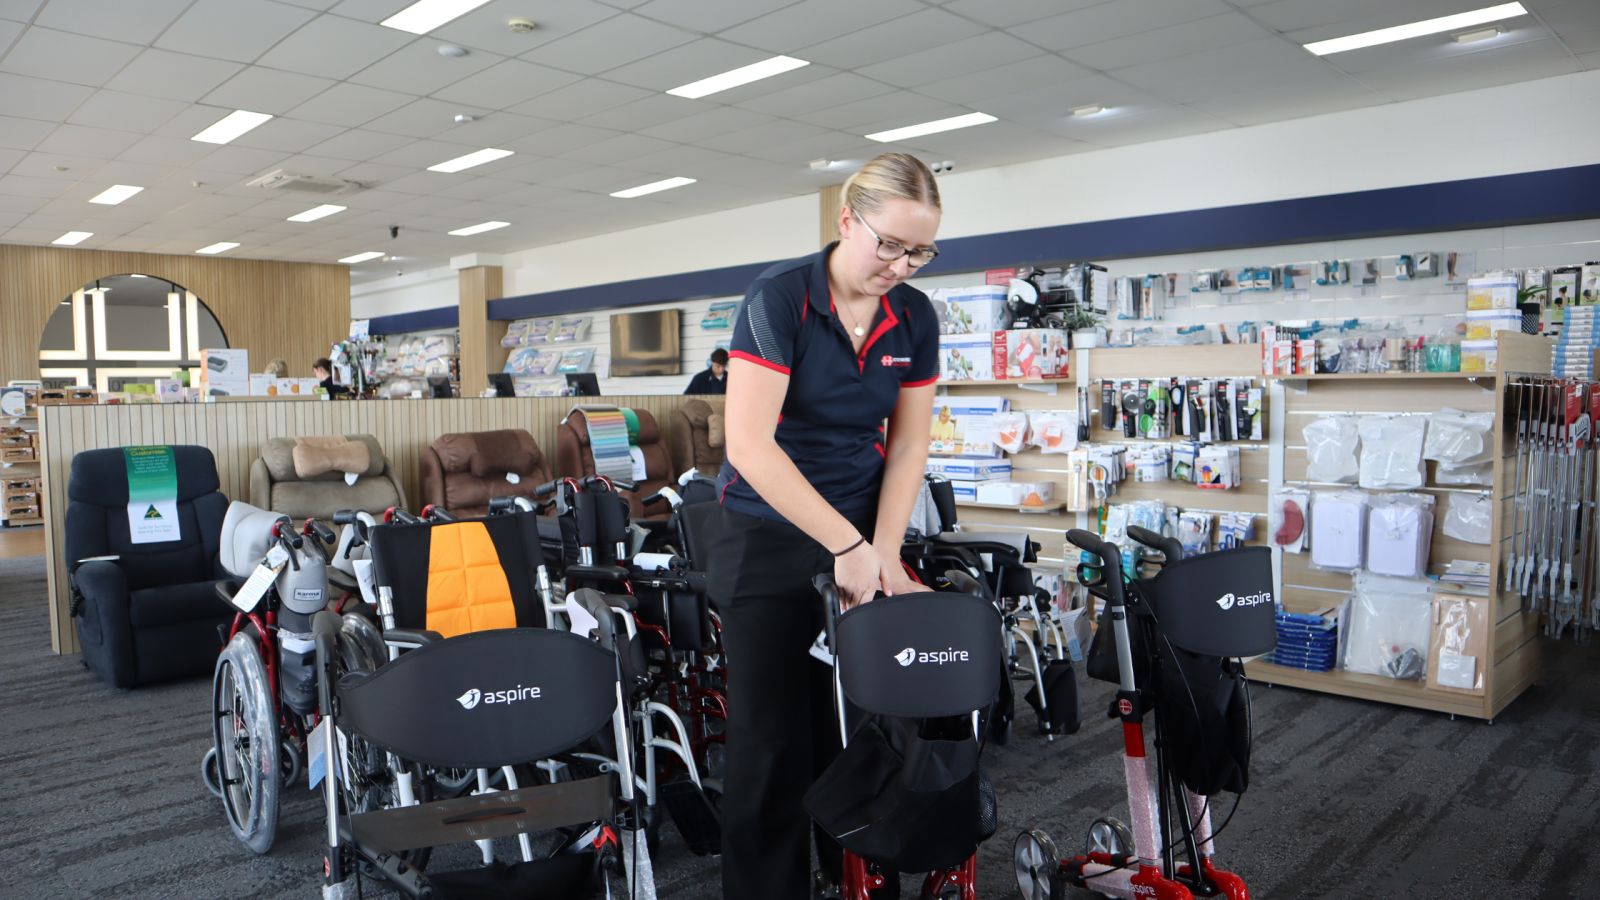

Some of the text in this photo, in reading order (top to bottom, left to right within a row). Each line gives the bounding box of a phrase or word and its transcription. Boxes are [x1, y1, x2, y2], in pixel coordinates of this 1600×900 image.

[1237, 590, 1272, 607] aspire
[918, 647, 970, 665] aspire
[484, 684, 541, 705] aspire
[1131, 882, 1156, 896] aspire
